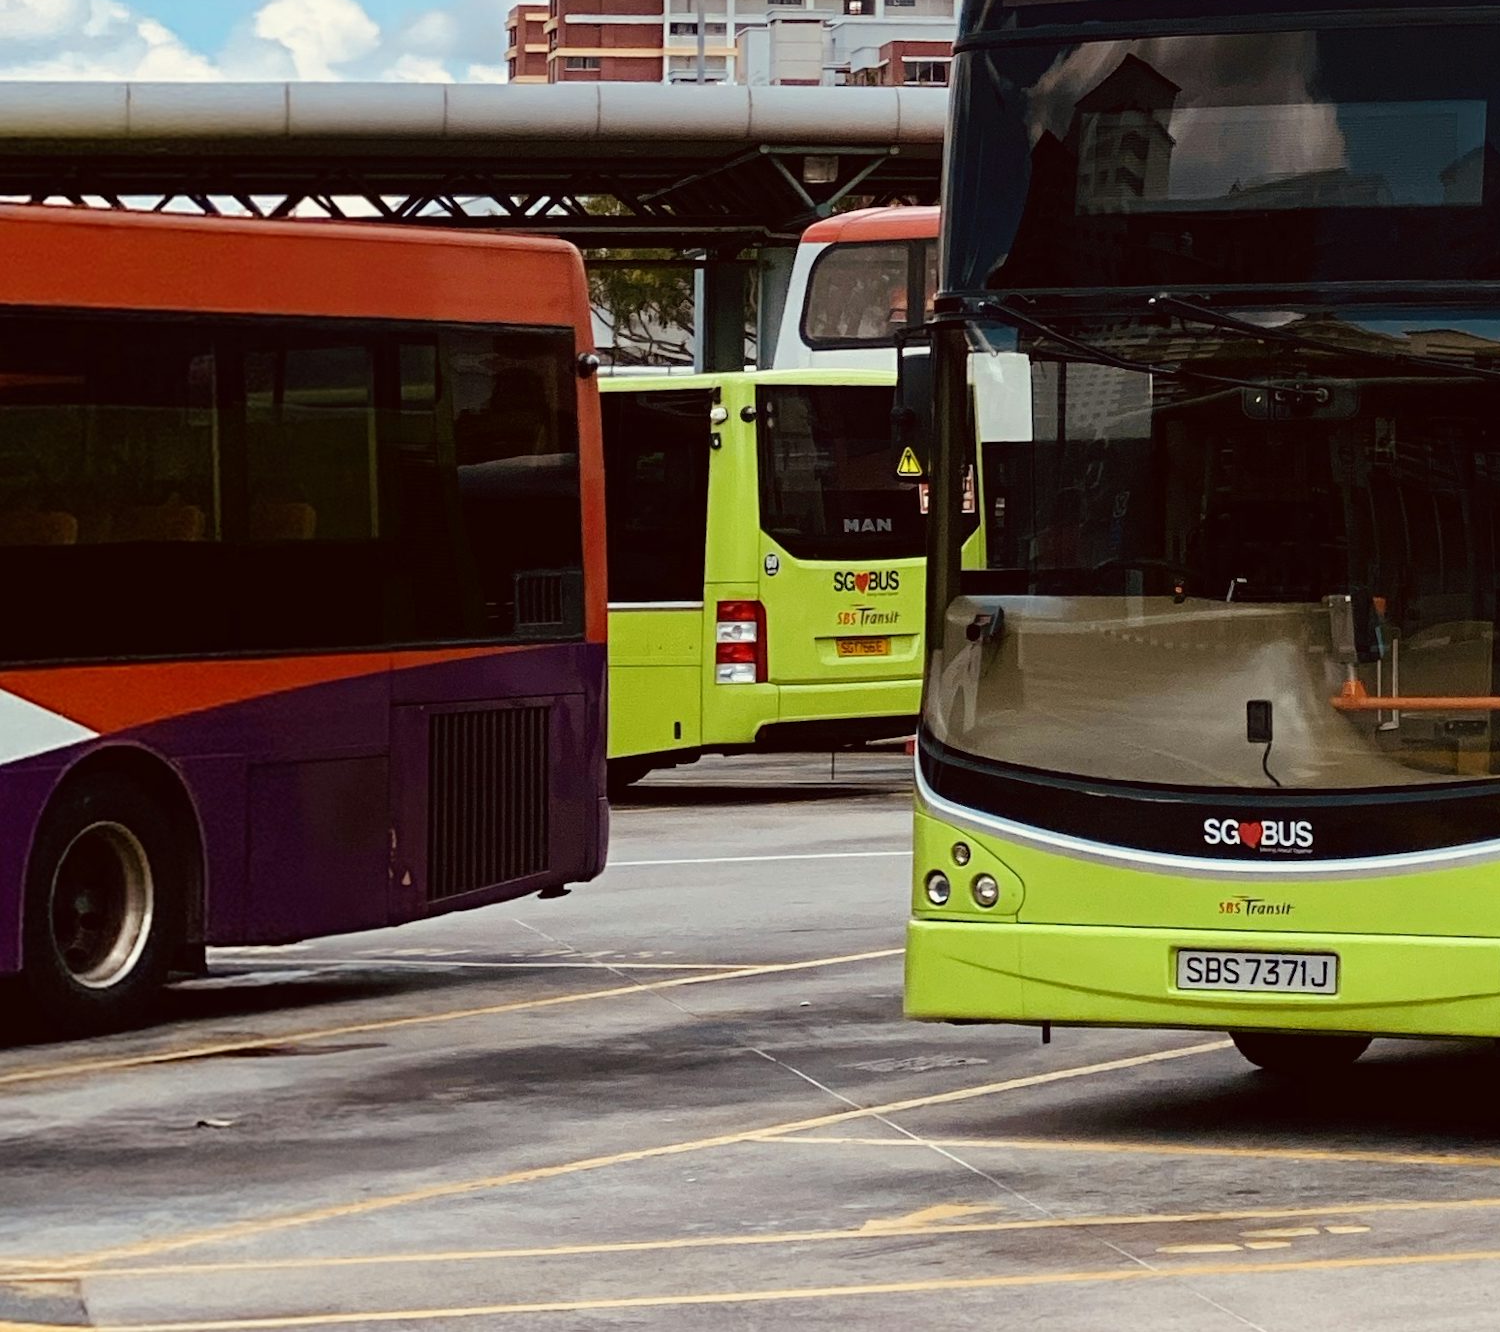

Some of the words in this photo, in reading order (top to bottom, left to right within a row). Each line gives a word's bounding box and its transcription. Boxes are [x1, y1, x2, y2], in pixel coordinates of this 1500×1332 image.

[843, 518, 892, 533] MAN
[837, 611, 857, 626] SBS
[856, 606, 901, 627] Transit
[1218, 901, 1241, 915] SBS
[1240, 898, 1295, 917] Transit
